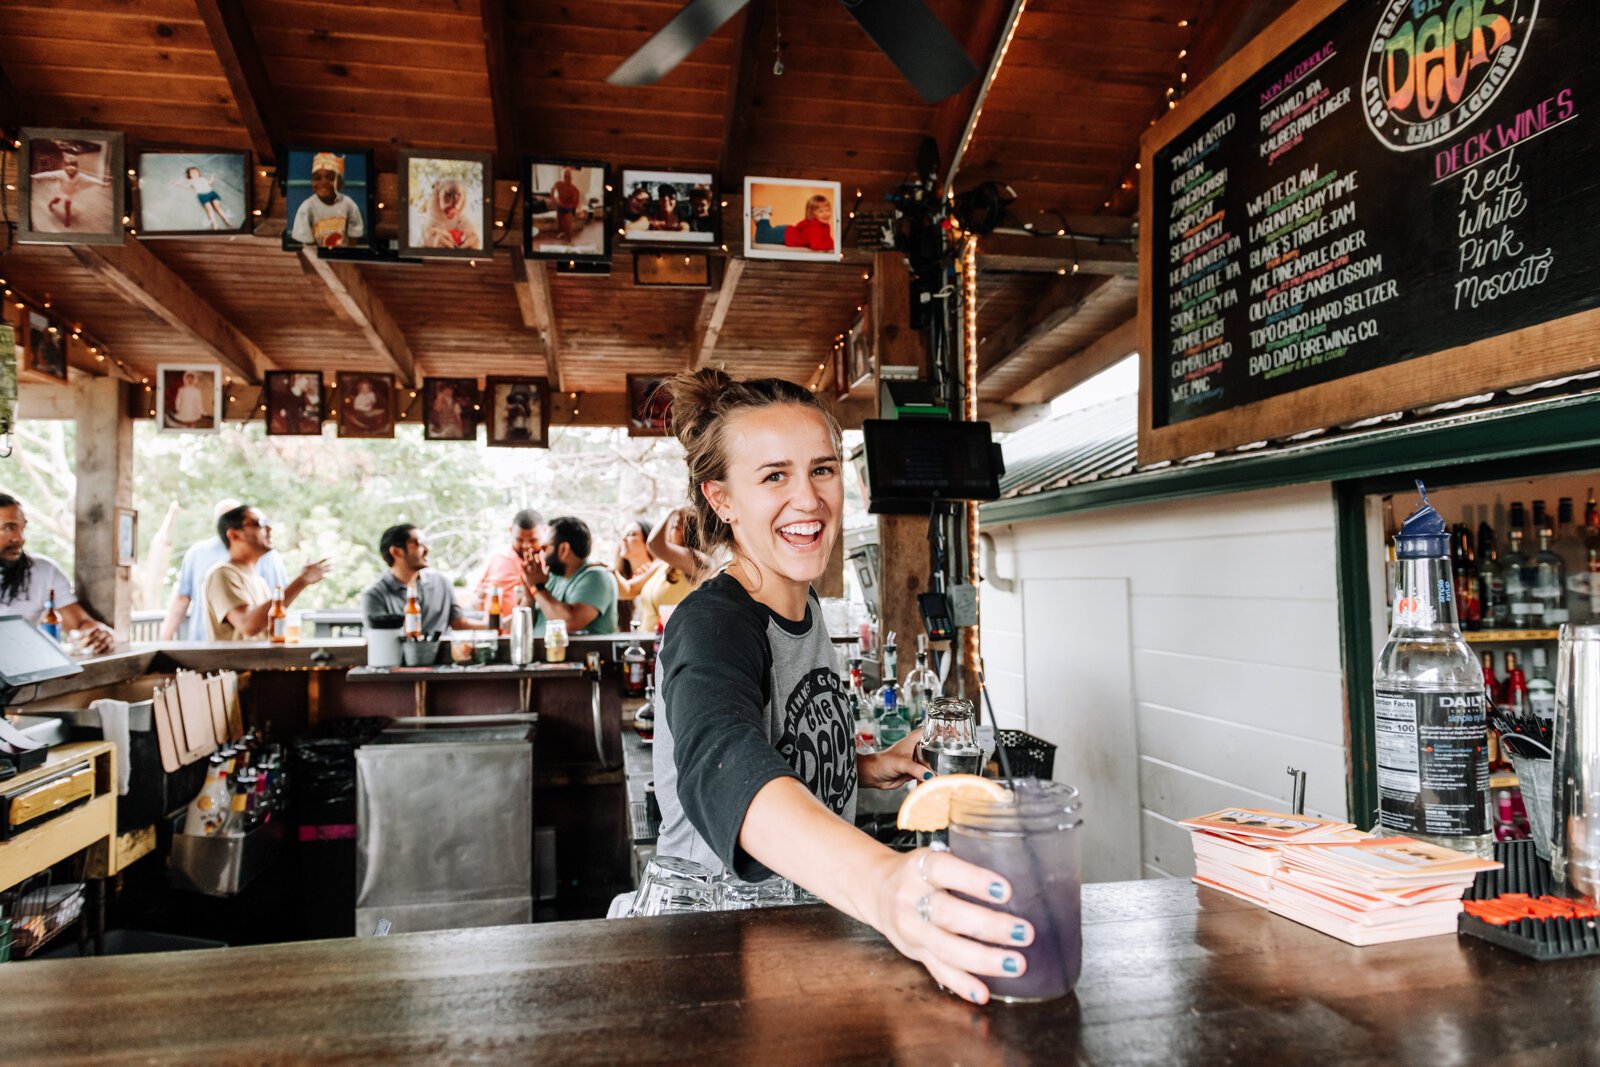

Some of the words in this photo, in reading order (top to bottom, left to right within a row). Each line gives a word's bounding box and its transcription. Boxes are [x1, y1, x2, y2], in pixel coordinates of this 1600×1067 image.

[1319, 86, 1351, 120] LAGER
[1366, 76, 1389, 128] COLD
[1457, 44, 1517, 124] MUDDY
[1260, 106, 1280, 132] RUN
[1280, 91, 1304, 117] WILD
[1406, 113, 1451, 144] RIVER
[1435, 128, 1494, 179] DECK
[1496, 88, 1575, 148] WINES
[1171, 146, 1192, 171] TWO
[1192, 112, 1236, 157] HEARTED
[1246, 181, 1285, 217] WHITE
[1285, 163, 1319, 197] CLAW
[1460, 148, 1520, 204] Red
[1248, 199, 1304, 243] LAGUNITAS
[1304, 170, 1359, 214] DAYTIME
[1458, 182, 1528, 238] White
[1249, 234, 1291, 269] BLAKE'S
[1292, 215, 1329, 248] TRIPLE
[1329, 200, 1356, 231] JAM
[1459, 225, 1524, 273] Pink
[1170, 262, 1192, 288] HEAD
[1193, 243, 1226, 273] HUNTER
[1226, 235, 1242, 256] IPA
[1170, 286, 1194, 310] HAZY
[1194, 269, 1223, 298] LITTLE
[1225, 261, 1242, 282] IPA
[1249, 290, 1289, 322] OLIVER
[1290, 254, 1383, 306] BEANBLOSSOM
[1250, 272, 1270, 297] ACE
[1271, 246, 1329, 285] PINEAPPLE
[1330, 230, 1367, 260] CIDER
[1454, 248, 1554, 310] Moscato
[1170, 307, 1196, 333] STONE
[1197, 296, 1223, 321] HAZY
[1223, 288, 1239, 309] IPA
[1171, 331, 1201, 355] ZOMBIE
[1202, 317, 1226, 339] DUST
[1249, 324, 1276, 349] TOPO
[1277, 312, 1309, 340] CHICO
[1310, 300, 1343, 326] HARD
[1343, 279, 1399, 315] SELTZER
[1249, 353, 1272, 376] BAD
[1273, 343, 1298, 368] DAD
[1300, 326, 1358, 359] BREWING
[1358, 319, 1379, 341] CO.
[1171, 381, 1189, 403] WEE
[1190, 377, 1211, 396] MAC
[804, 698, 834, 733] the
[1393, 700, 1415, 708] Facts
[1398, 724, 1415, 733] 100
